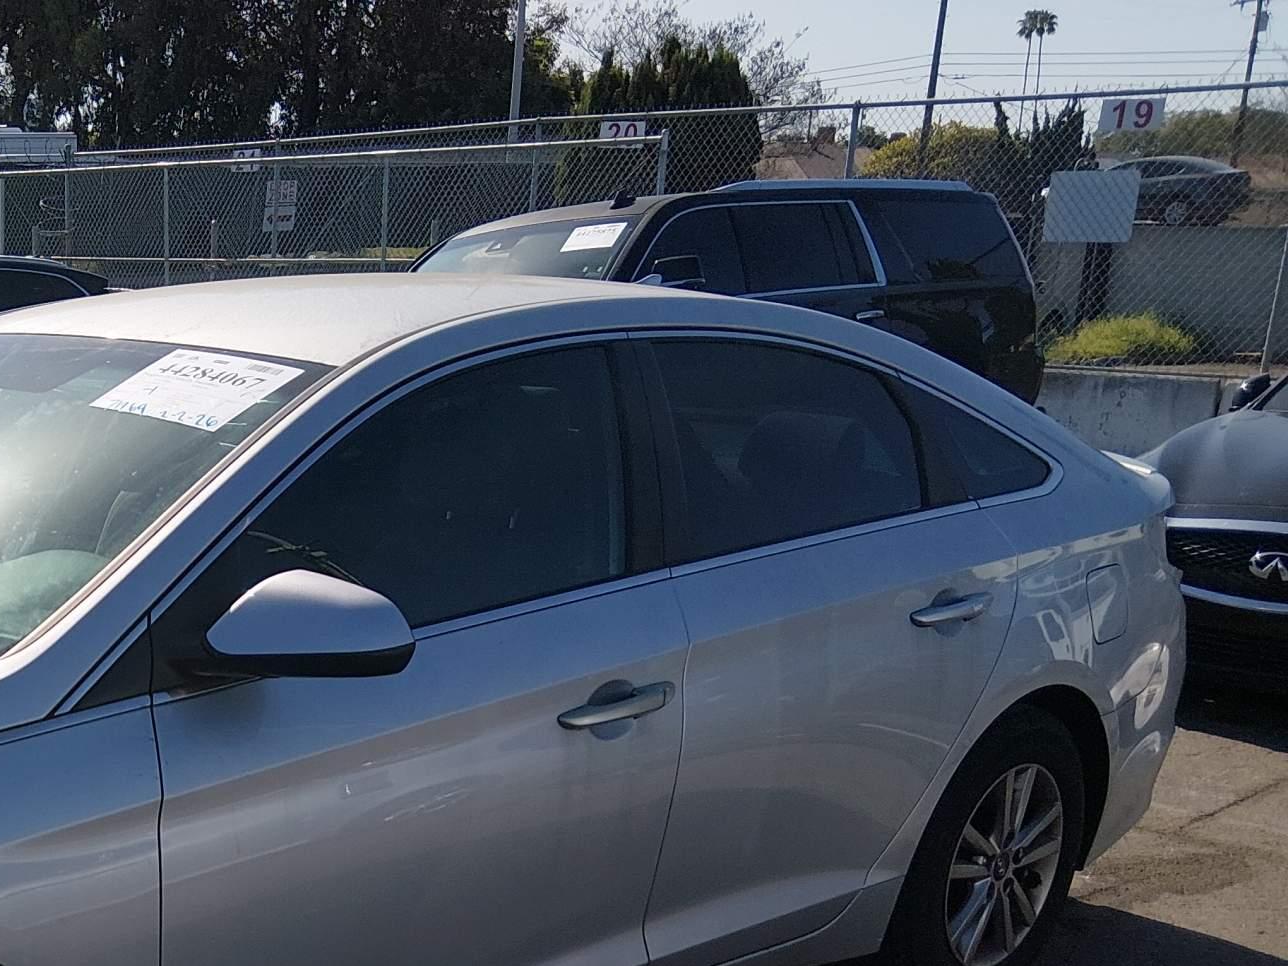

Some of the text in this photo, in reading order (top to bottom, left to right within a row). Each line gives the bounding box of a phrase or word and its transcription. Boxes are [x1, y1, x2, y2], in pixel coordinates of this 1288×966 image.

[1113, 100, 1153, 128] 19
[608, 123, 638, 138] 20
[159, 363, 268, 389] 44284067
